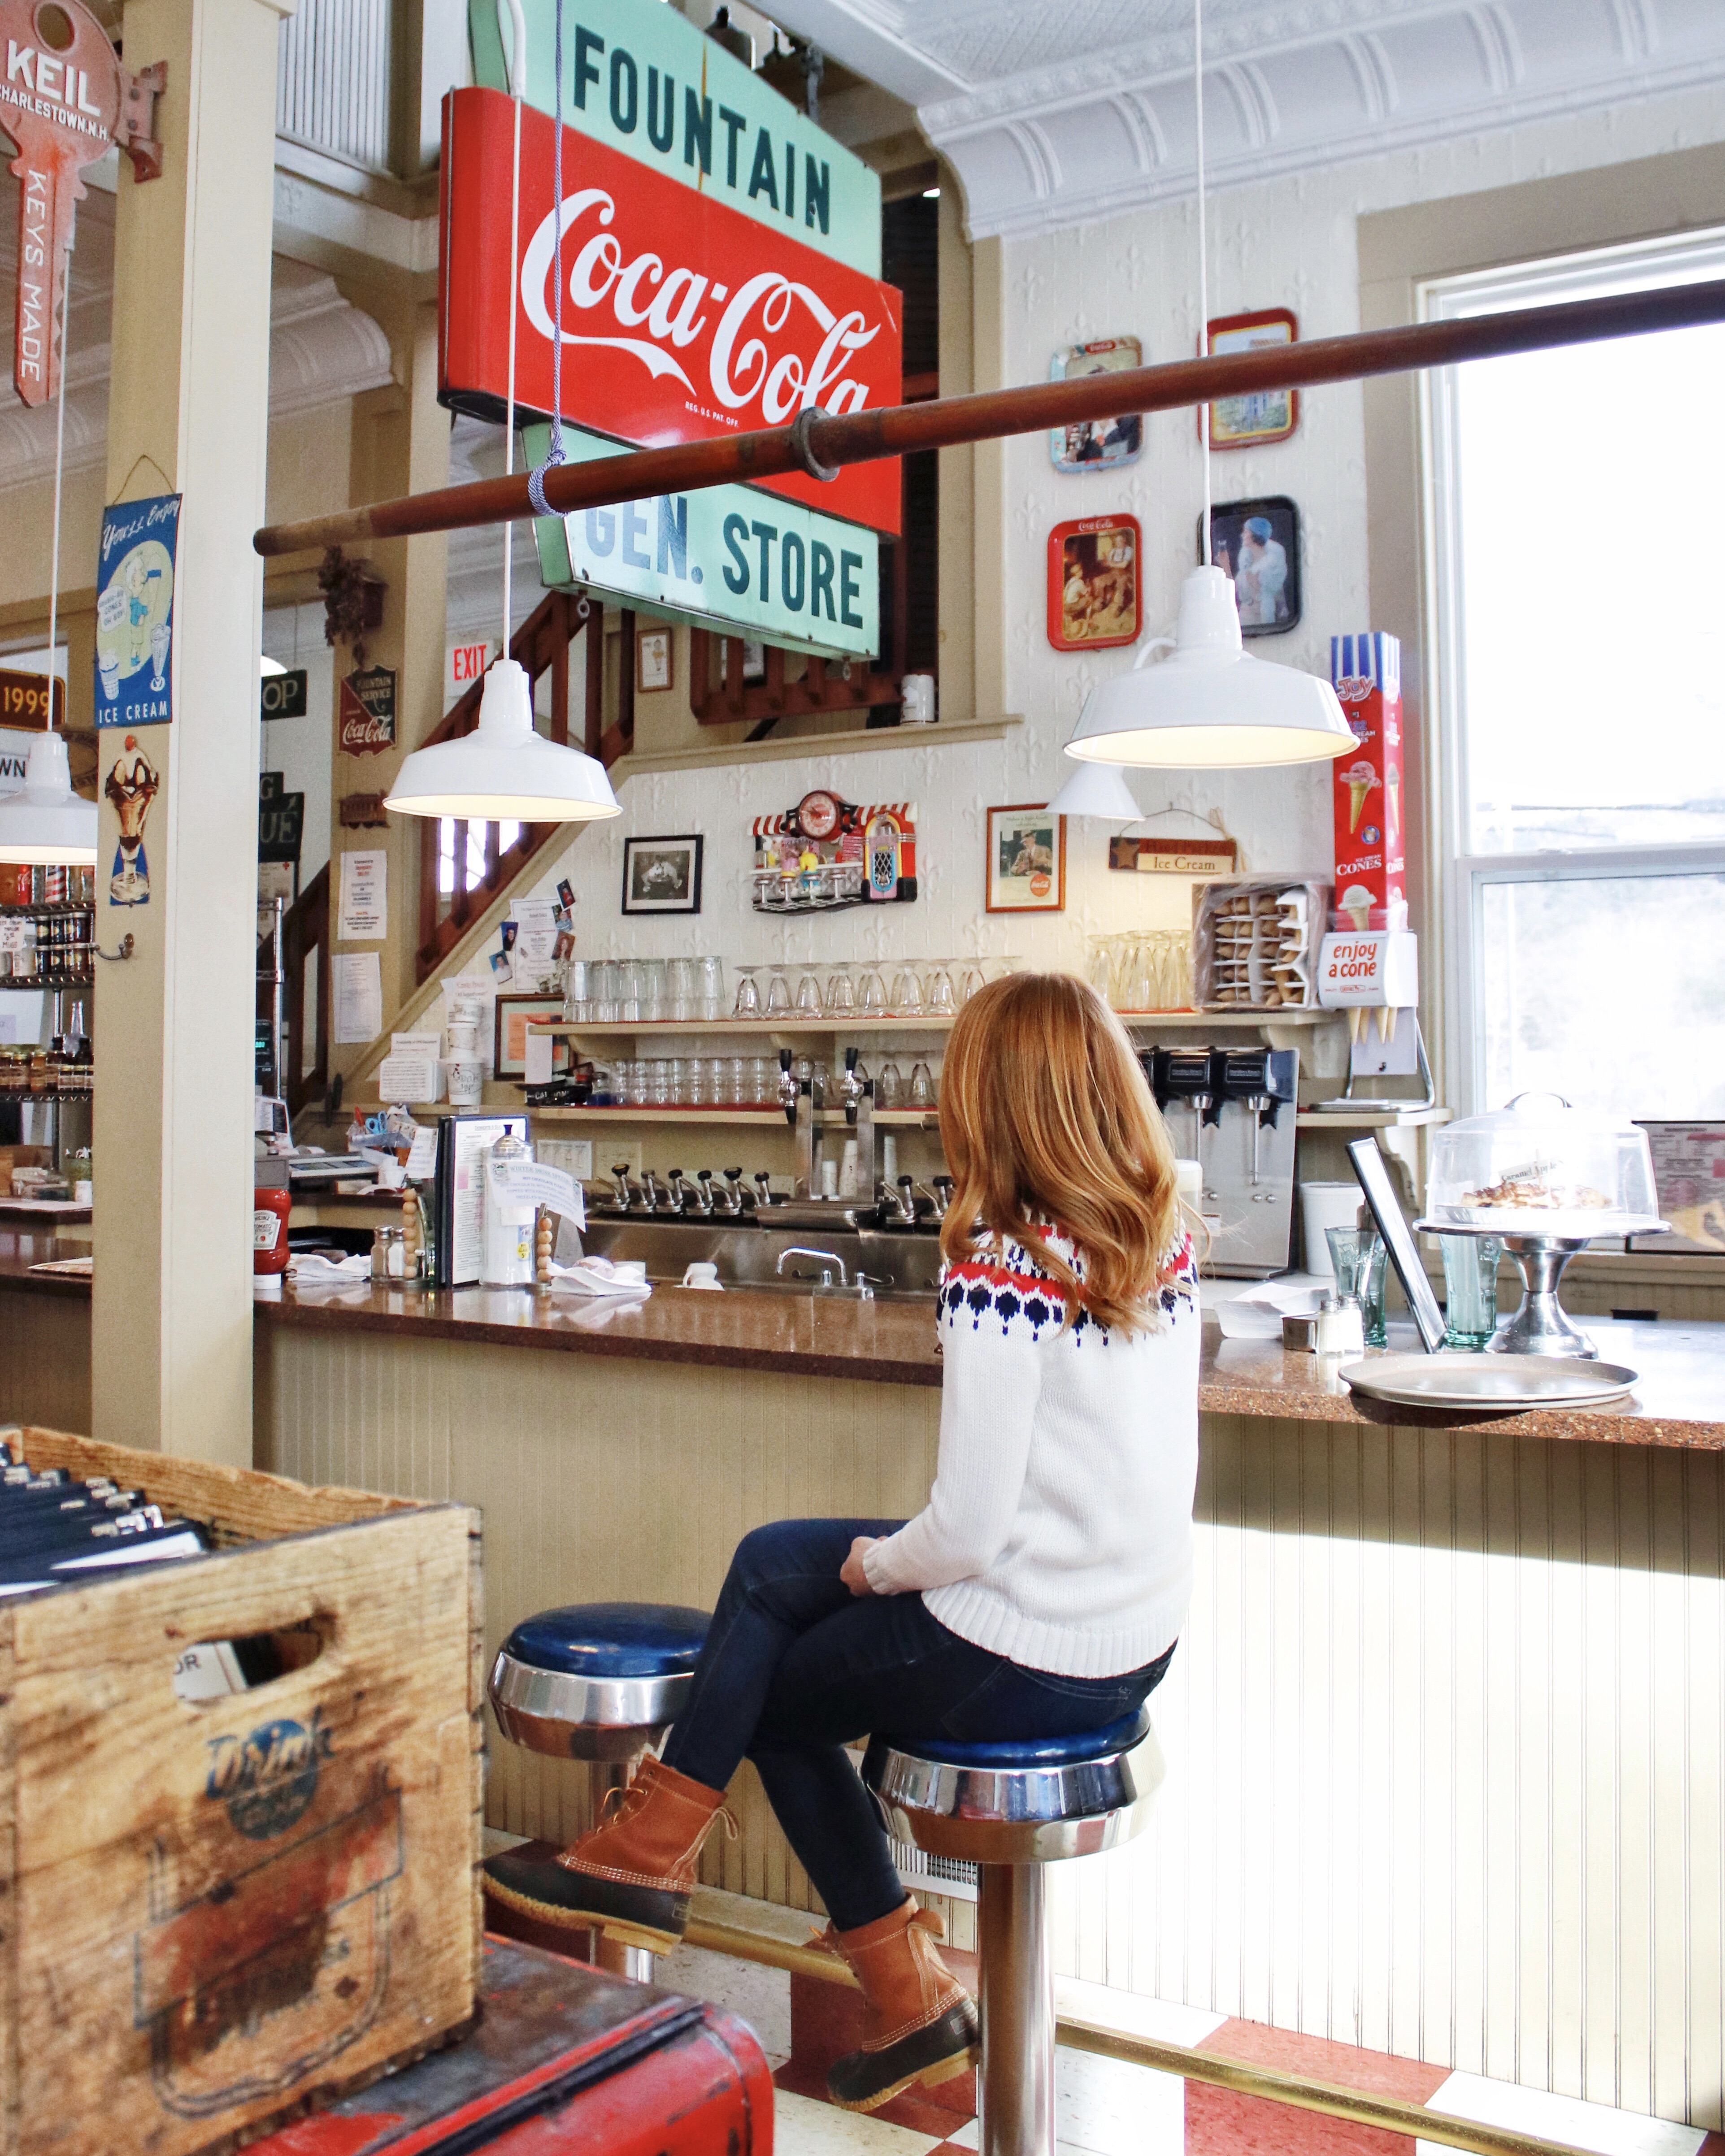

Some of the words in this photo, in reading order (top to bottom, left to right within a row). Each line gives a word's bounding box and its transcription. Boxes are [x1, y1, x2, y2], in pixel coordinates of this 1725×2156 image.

[7, 39, 101, 117] KEIL
[574, 23, 830, 235] FOUNTAIN
[25, 169, 47, 267] KEYS
[521, 188, 882, 424] Coca-Cola
[21, 282, 42, 382] MADE
[685, 401, 700, 413] REG.
[700, 407, 711, 417] U.S.
[712, 411, 725, 422] PAT.
[726, 416, 739, 427] OFF.
[146, 500, 180, 526] Enjoy
[585, 493, 704, 585] GEN.
[722, 512, 864, 629] STORE
[452, 644, 487, 681] EXIT
[4, 685, 49, 716] 1999
[99, 707, 118, 724] ICE
[126, 700, 168, 720] CREAM
[1154, 856, 1170, 869] Ice
[1175, 856, 1216, 870] Cream
[1336, 859, 1382, 876] CONES
[1334, 941, 1377, 962] enjoy
[1329, 964, 1338, 977] a
[1340, 962, 1377, 977] cone
[1501, 1167, 1533, 1181] Caramel
[1535, 1162, 1558, 1175] Apple
